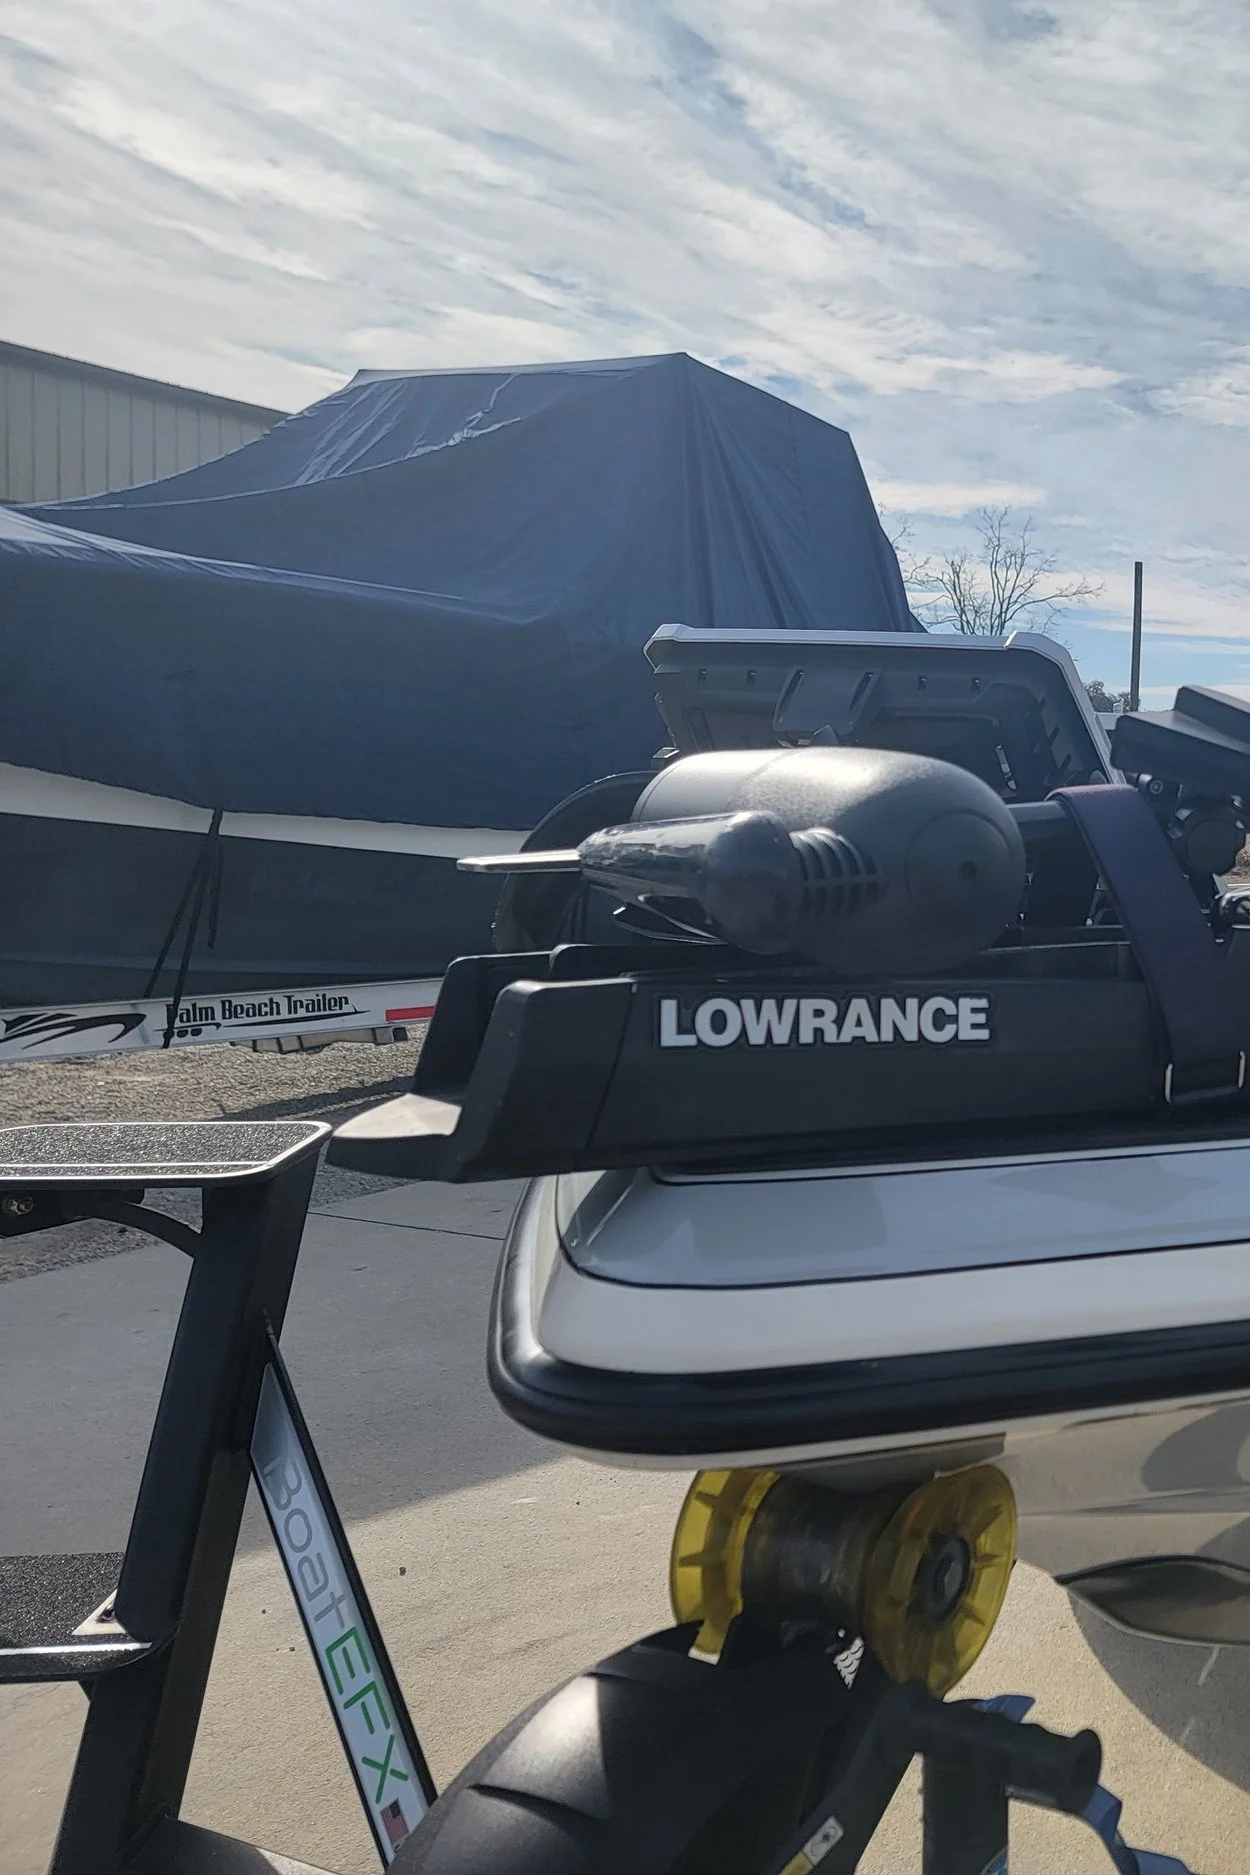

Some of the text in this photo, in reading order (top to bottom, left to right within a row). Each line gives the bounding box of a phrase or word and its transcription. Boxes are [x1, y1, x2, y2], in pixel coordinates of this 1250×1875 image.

[220, 997, 281, 1020] Beach
[283, 992, 349, 1015] Trailer
[660, 996, 991, 1047] LOWRANCE
